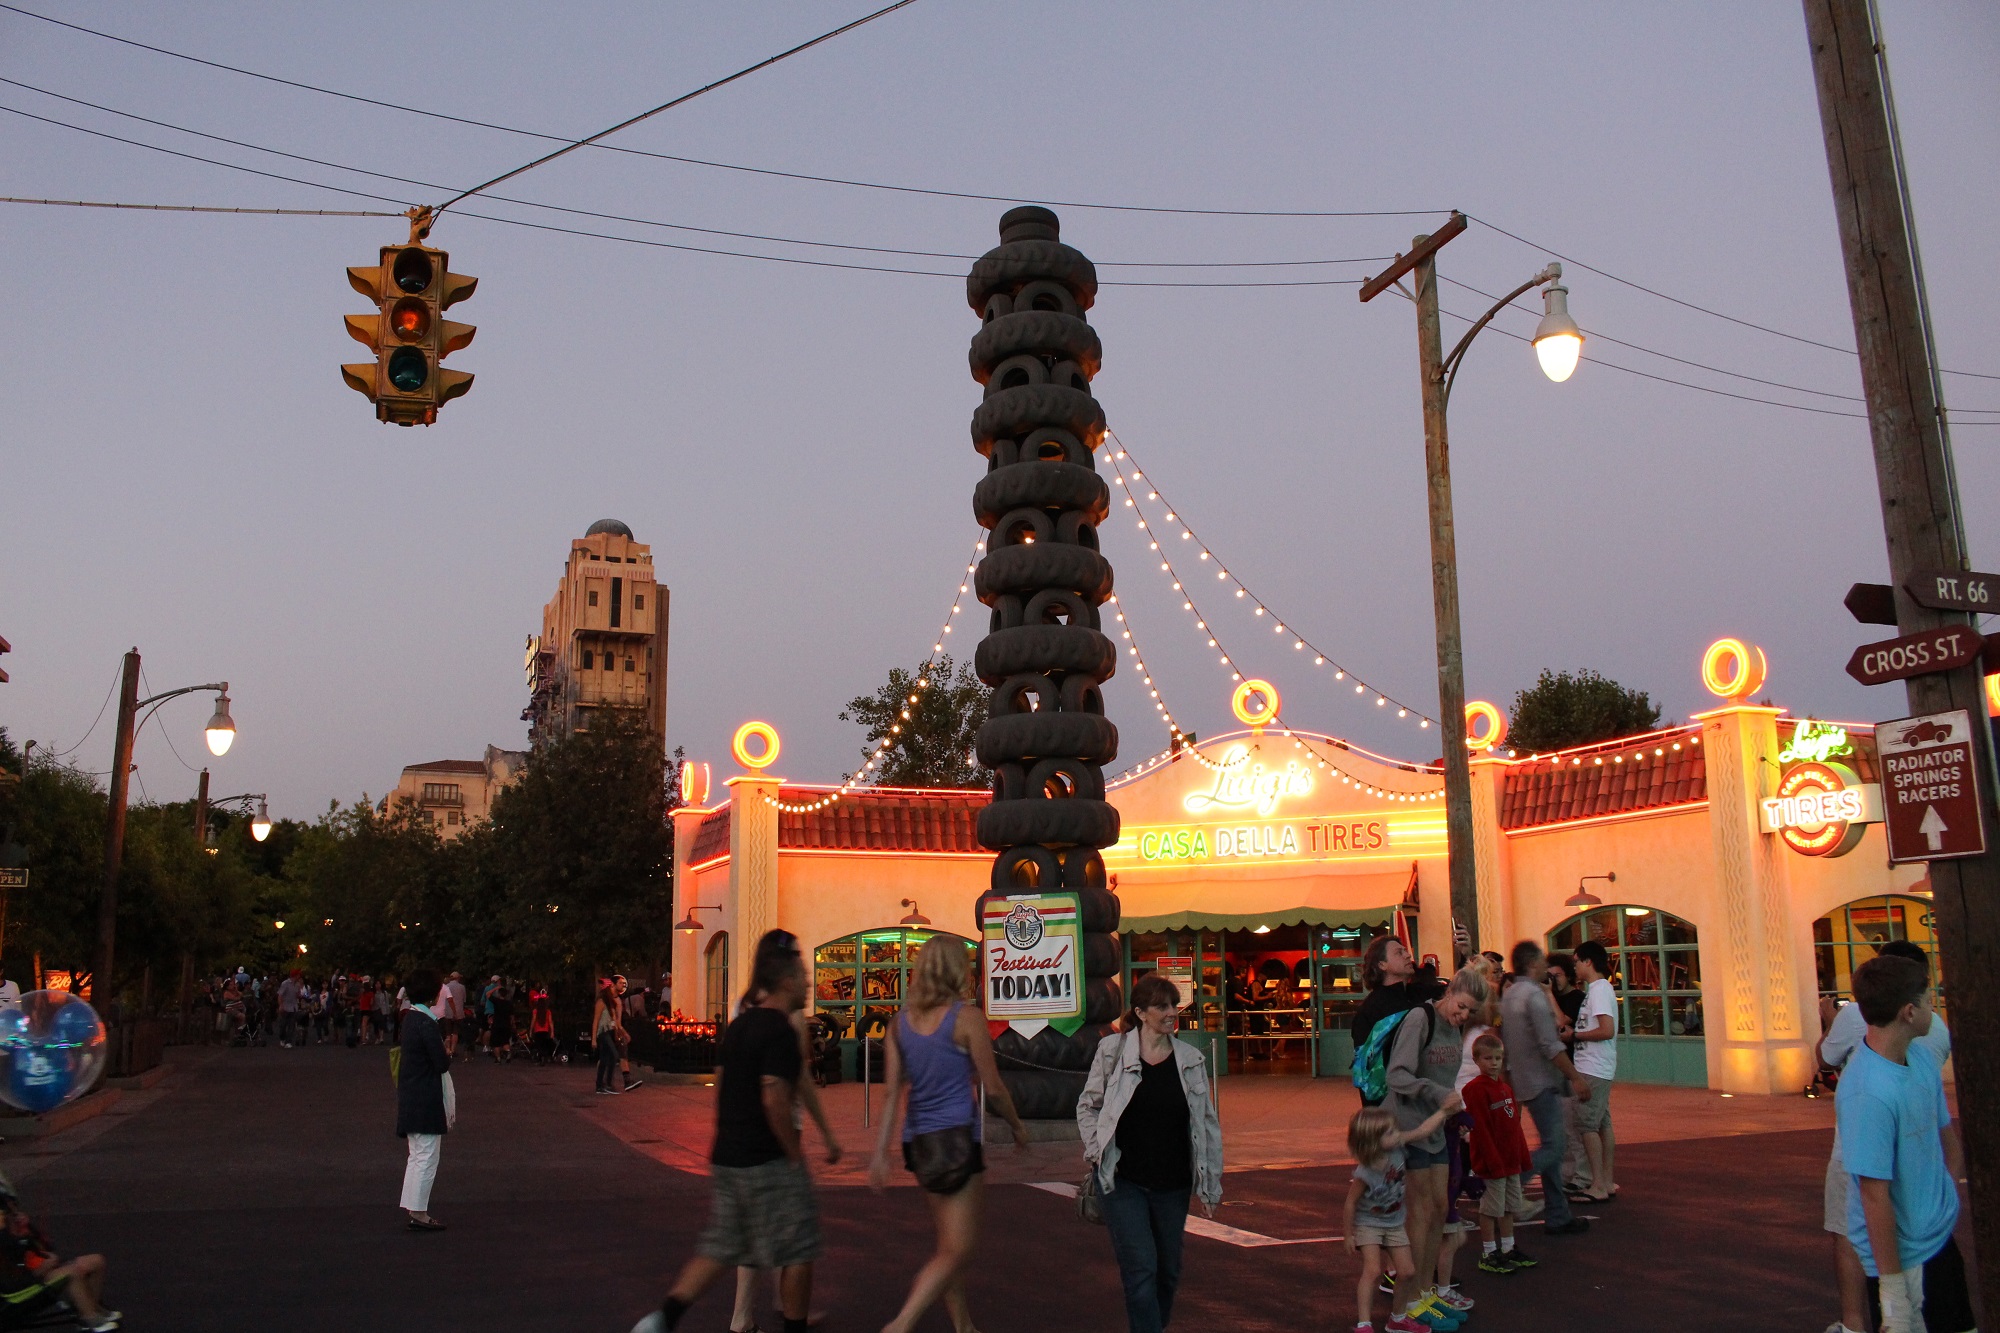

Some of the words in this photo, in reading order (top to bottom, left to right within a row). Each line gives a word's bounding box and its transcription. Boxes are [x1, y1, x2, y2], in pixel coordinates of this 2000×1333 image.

[1936, 577, 1962, 601] RT.
[1967, 580, 1989, 603] 66
[1863, 641, 1930, 676] CROSS
[1934, 633, 1965, 661] ST.
[1886, 748, 1965, 773] RADIATOR
[1893, 766, 1961, 789] SPRINGS
[1897, 783, 1961, 804] RACERS
[1762, 789, 1863, 828] TIRES
[1141, 831, 1209, 861] CASA
[1216, 826, 1299, 857] DELLA
[1306, 822, 1384, 852] TIRES
[0, 875, 23, 884] PEN
[990, 944, 1069, 973] Festival
[990, 973, 1071, 1001] TODAY!
